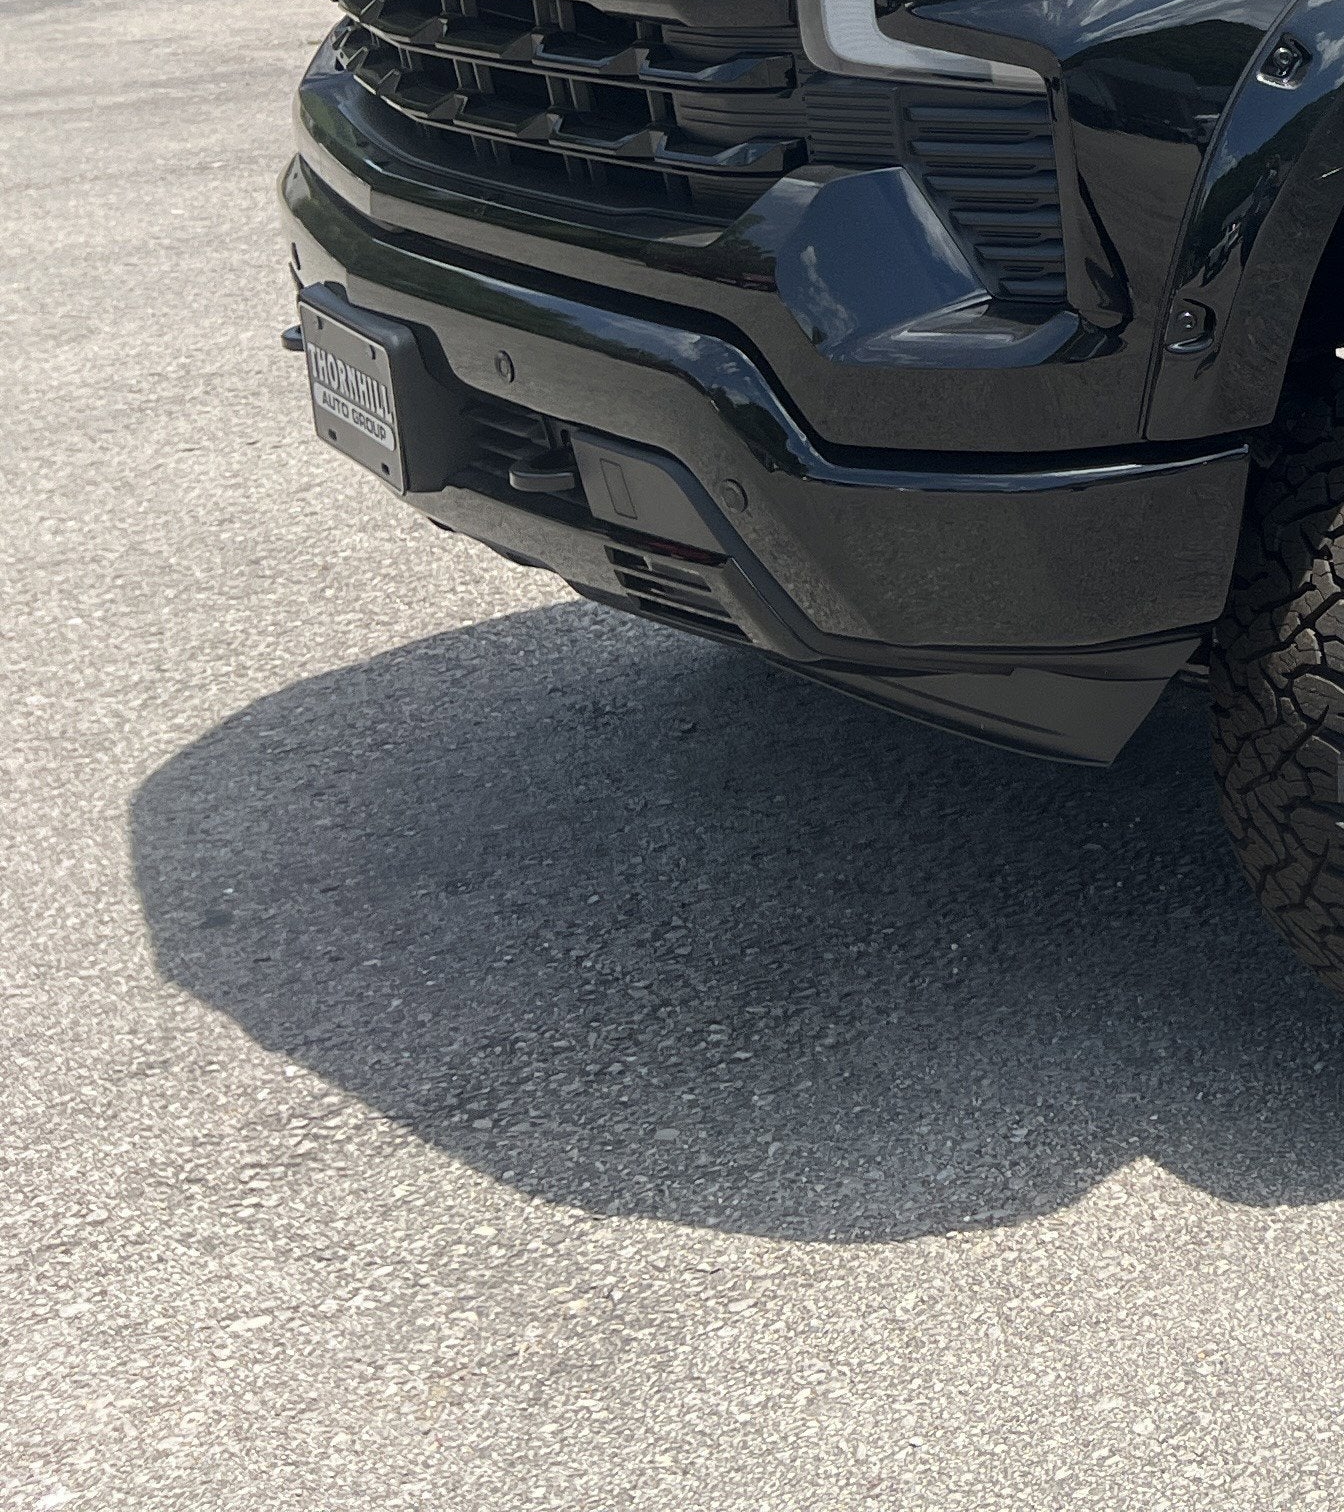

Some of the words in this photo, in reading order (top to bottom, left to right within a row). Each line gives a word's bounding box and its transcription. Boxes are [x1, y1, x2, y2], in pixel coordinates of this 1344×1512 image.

[307, 341, 394, 422] THORNHILL
[321, 390, 349, 419] AUTO
[351, 408, 387, 441] GROUP
